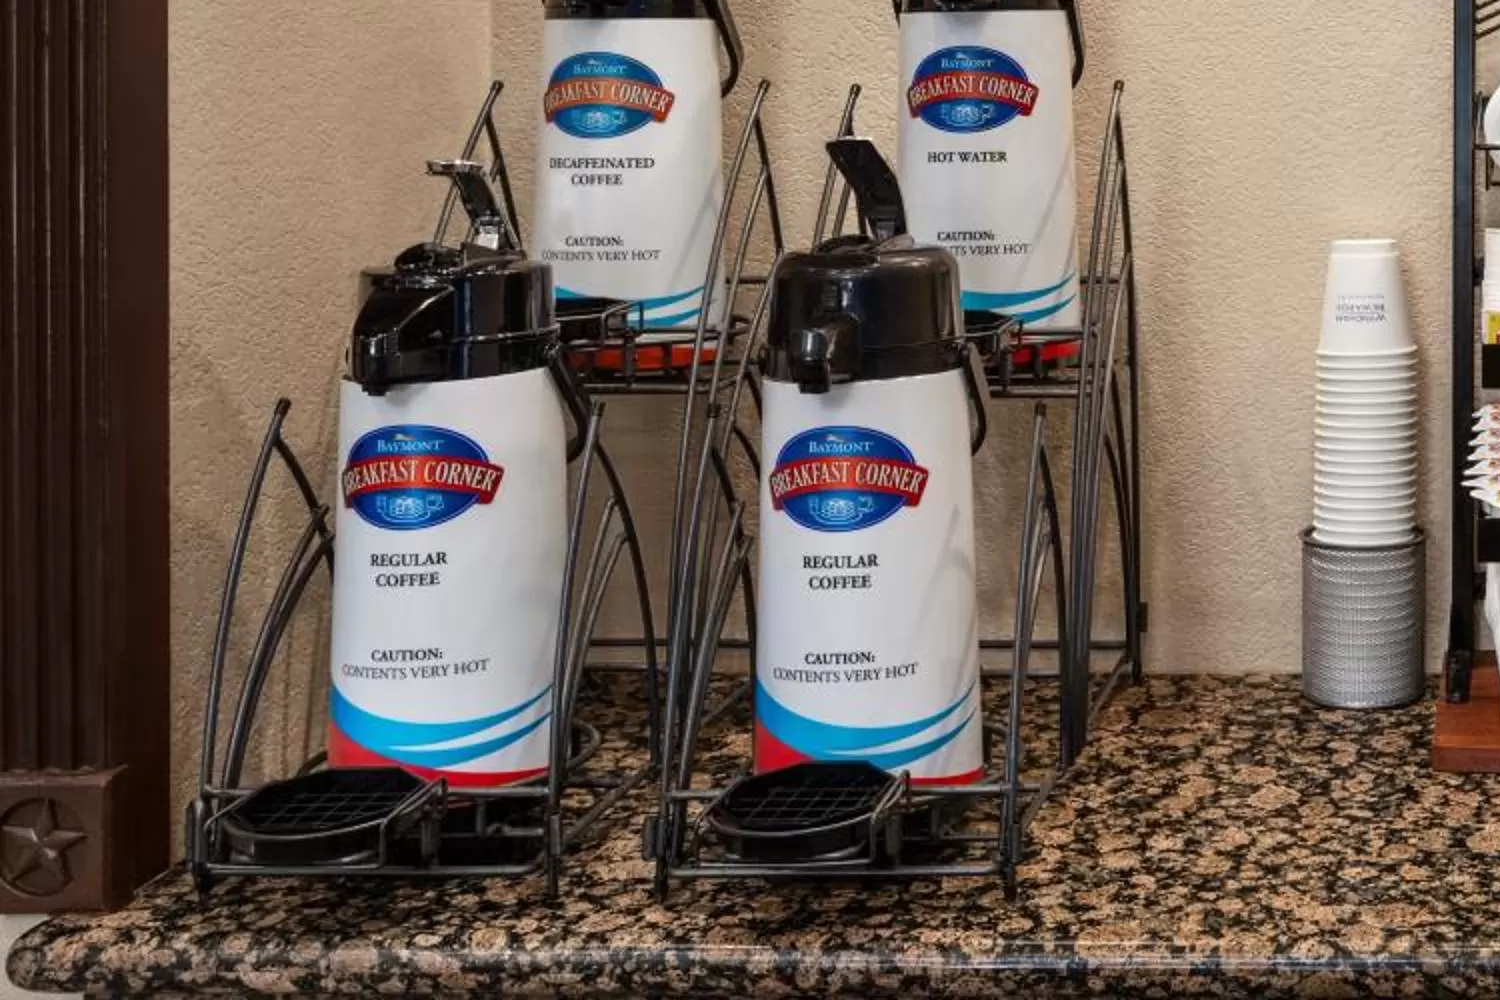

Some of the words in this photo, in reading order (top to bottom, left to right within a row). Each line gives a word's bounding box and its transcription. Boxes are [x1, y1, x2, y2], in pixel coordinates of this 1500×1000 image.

[573, 64, 627, 74] BAYMONT
[941, 59, 993, 69] BAYMONT
[611, 83, 668, 113] CORNER
[910, 75, 976, 107] BREAKFAST
[979, 76, 1034, 107] CORNER
[549, 157, 656, 169] DECAFFEINATED
[927, 151, 955, 163] HOT
[957, 151, 1008, 163] WATER
[571, 173, 623, 185] COFFEE
[937, 230, 995, 241] CAUTION:
[596, 250, 629, 261] VERY
[631, 248, 661, 261] HOT
[969, 244, 1000, 256] VERY
[1003, 243, 1032, 255] HOT
[377, 439, 442, 452] BAYMONT
[809, 441, 872, 454] BAYMONT
[345, 460, 419, 495] BREAKFAST
[424, 460, 496, 492] CORNER
[771, 461, 851, 498] BREAKFAST
[855, 462, 922, 494] CORNER
[370, 551, 448, 567] REGULAR
[803, 553, 880, 569] REGULAR
[375, 572, 441, 587] COFFEE
[808, 574, 873, 590] COFFEE
[371, 648, 443, 662] CAUTION:
[804, 651, 877, 665] CAUTION:
[341, 663, 408, 680] CONTENTS
[410, 663, 450, 679] VERY
[453, 658, 491, 675] HOT
[772, 667, 841, 683] CONTENTS
[843, 668, 882, 681] VERY
[885, 661, 919, 679] HOT
